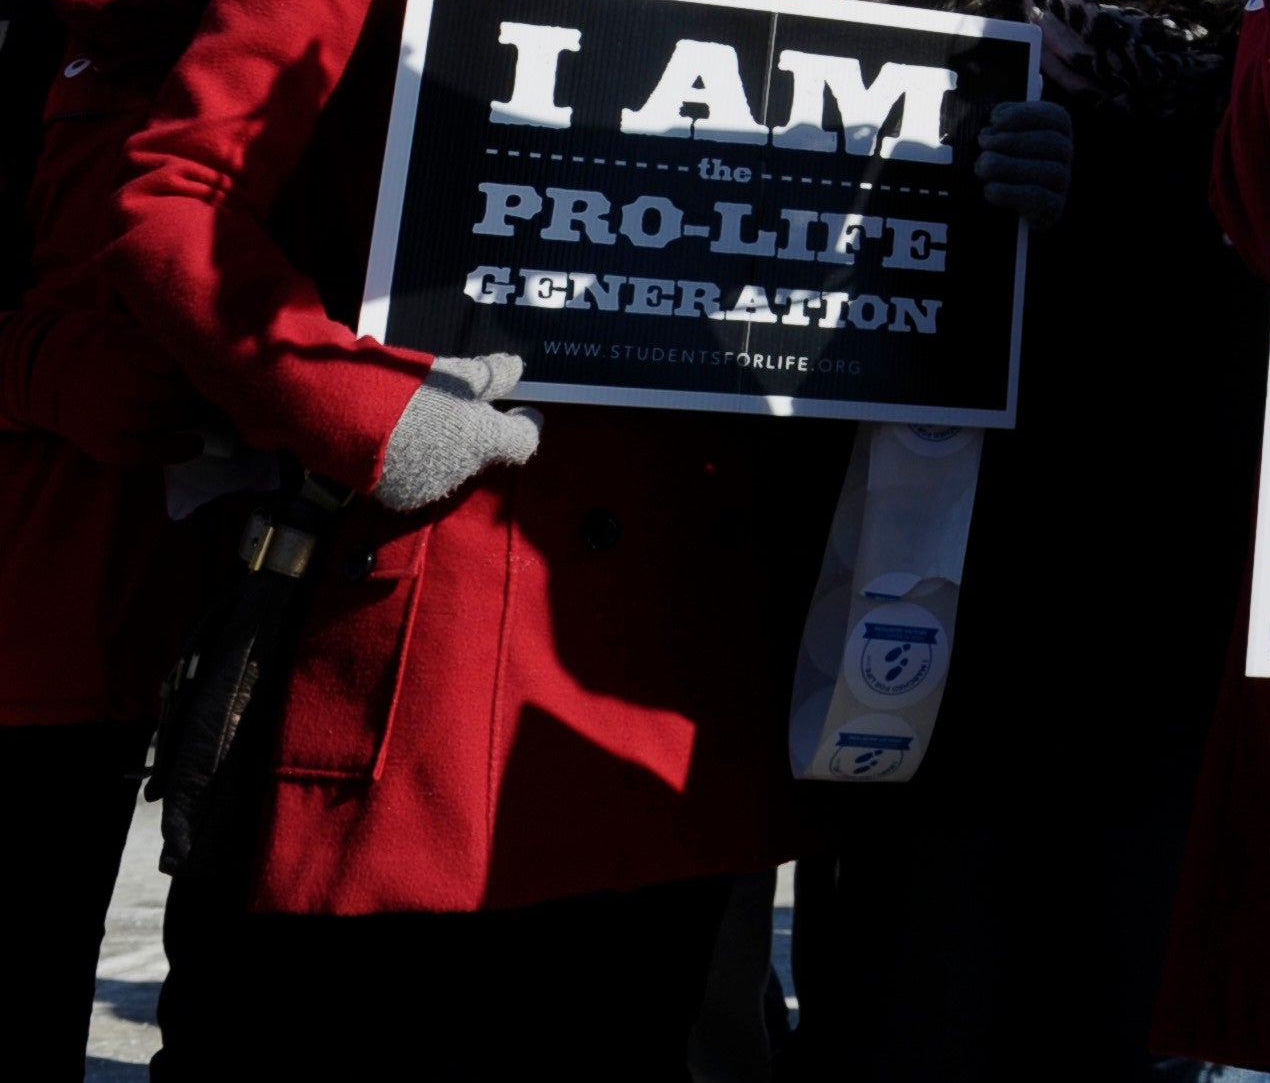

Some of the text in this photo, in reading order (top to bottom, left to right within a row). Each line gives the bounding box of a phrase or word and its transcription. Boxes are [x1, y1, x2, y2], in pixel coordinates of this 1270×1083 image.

[489, 21, 958, 165] I AM
[698, 157, 752, 184] the
[472, 182, 949, 272] PRO-LIFE
[464, 265, 943, 334] GENERATION
[543, 339, 862, 376] WWW.STUDENTSFORLIFE.ORG
